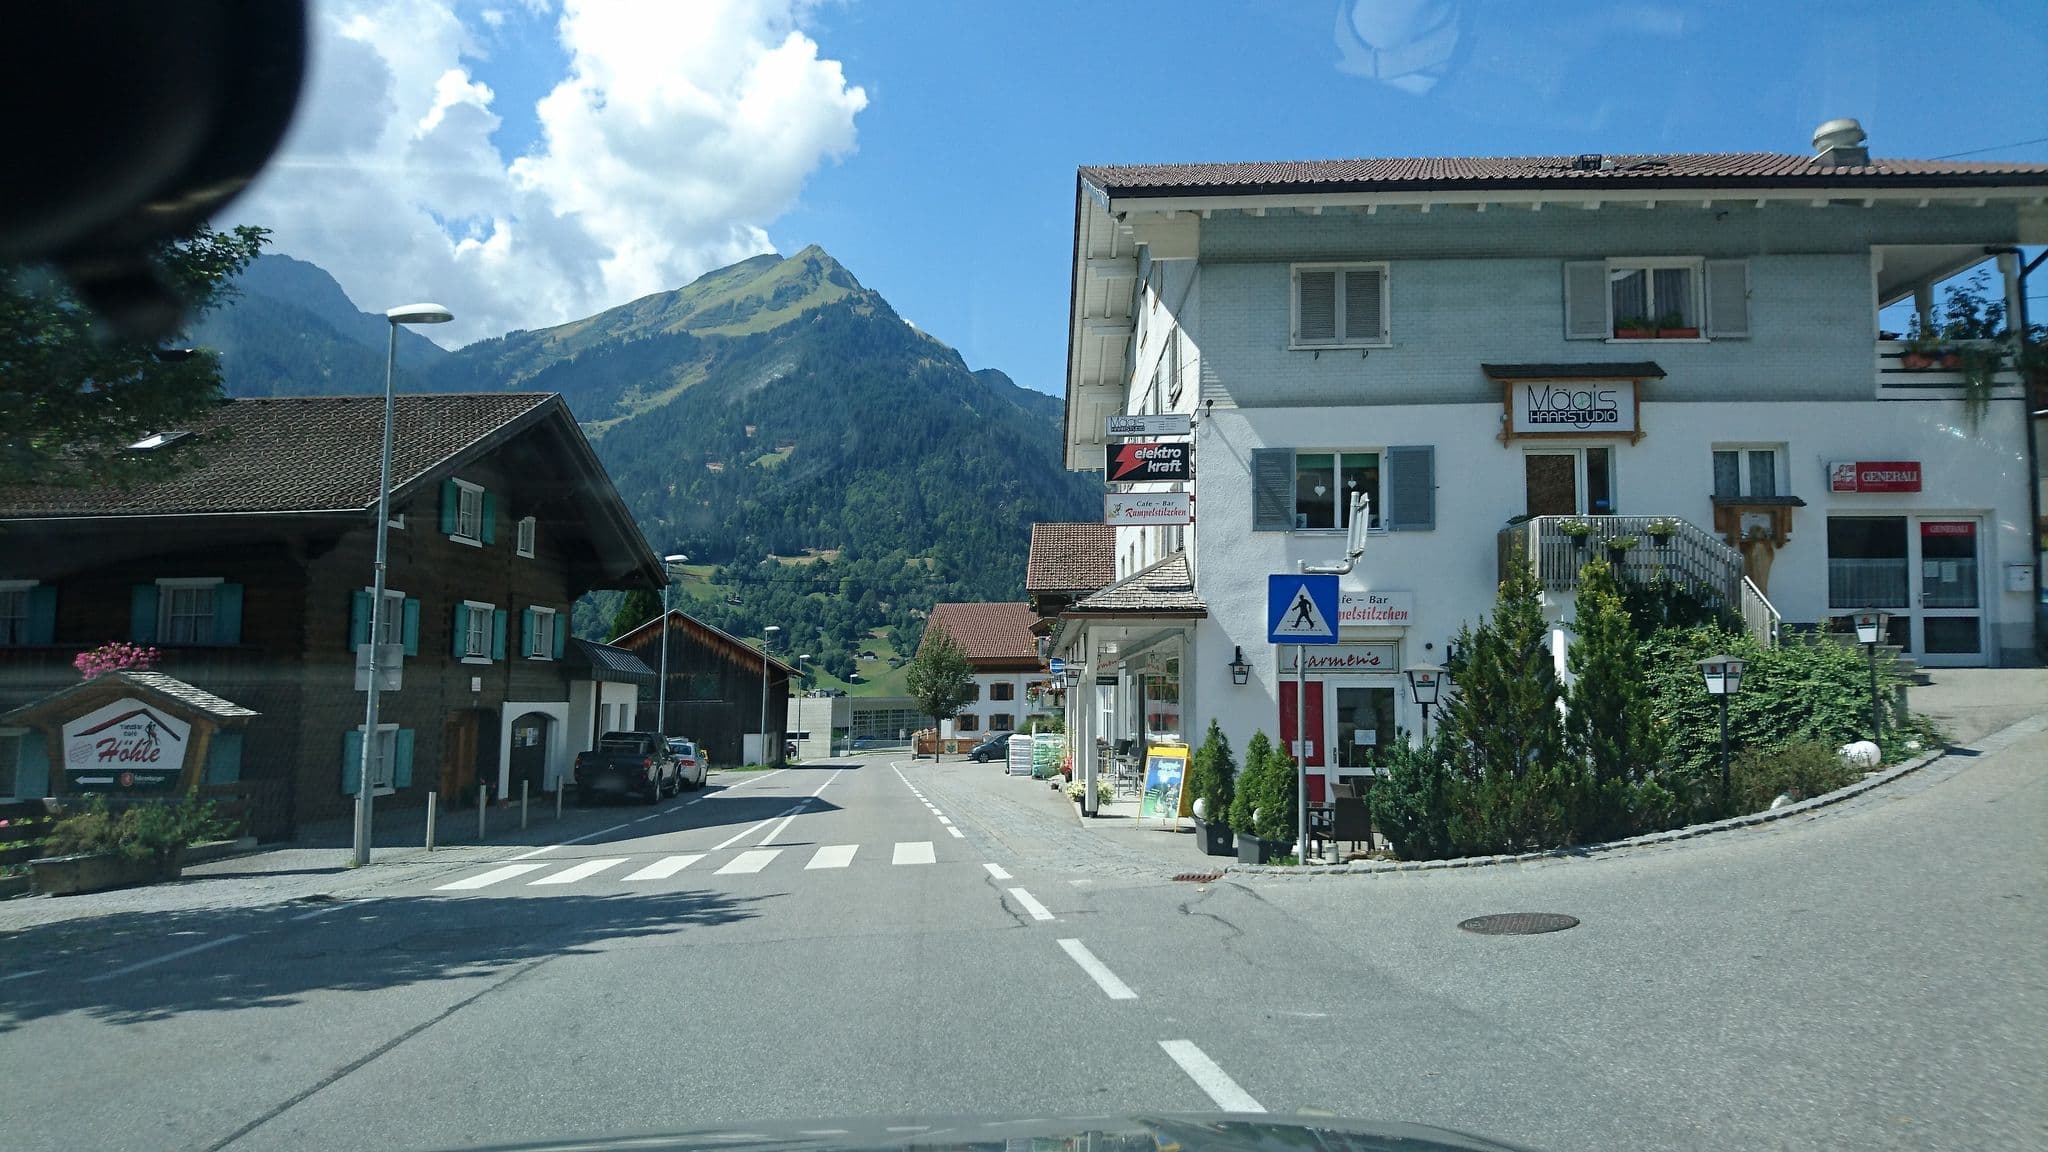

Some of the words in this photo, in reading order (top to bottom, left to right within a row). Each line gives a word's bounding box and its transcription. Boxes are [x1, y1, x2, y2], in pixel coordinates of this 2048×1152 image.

[1528, 384, 1617, 429] Mägis
[1530, 410, 1617, 422] HAARSTUDIO
[1135, 447, 1181, 458] elektro
[1148, 460, 1182, 472] kraft
[1861, 471, 1918, 482] GENERALI
[1341, 595, 1352, 604] fe
[1369, 595, 1389, 604] Bar
[96, 737, 161, 763] Höhle
